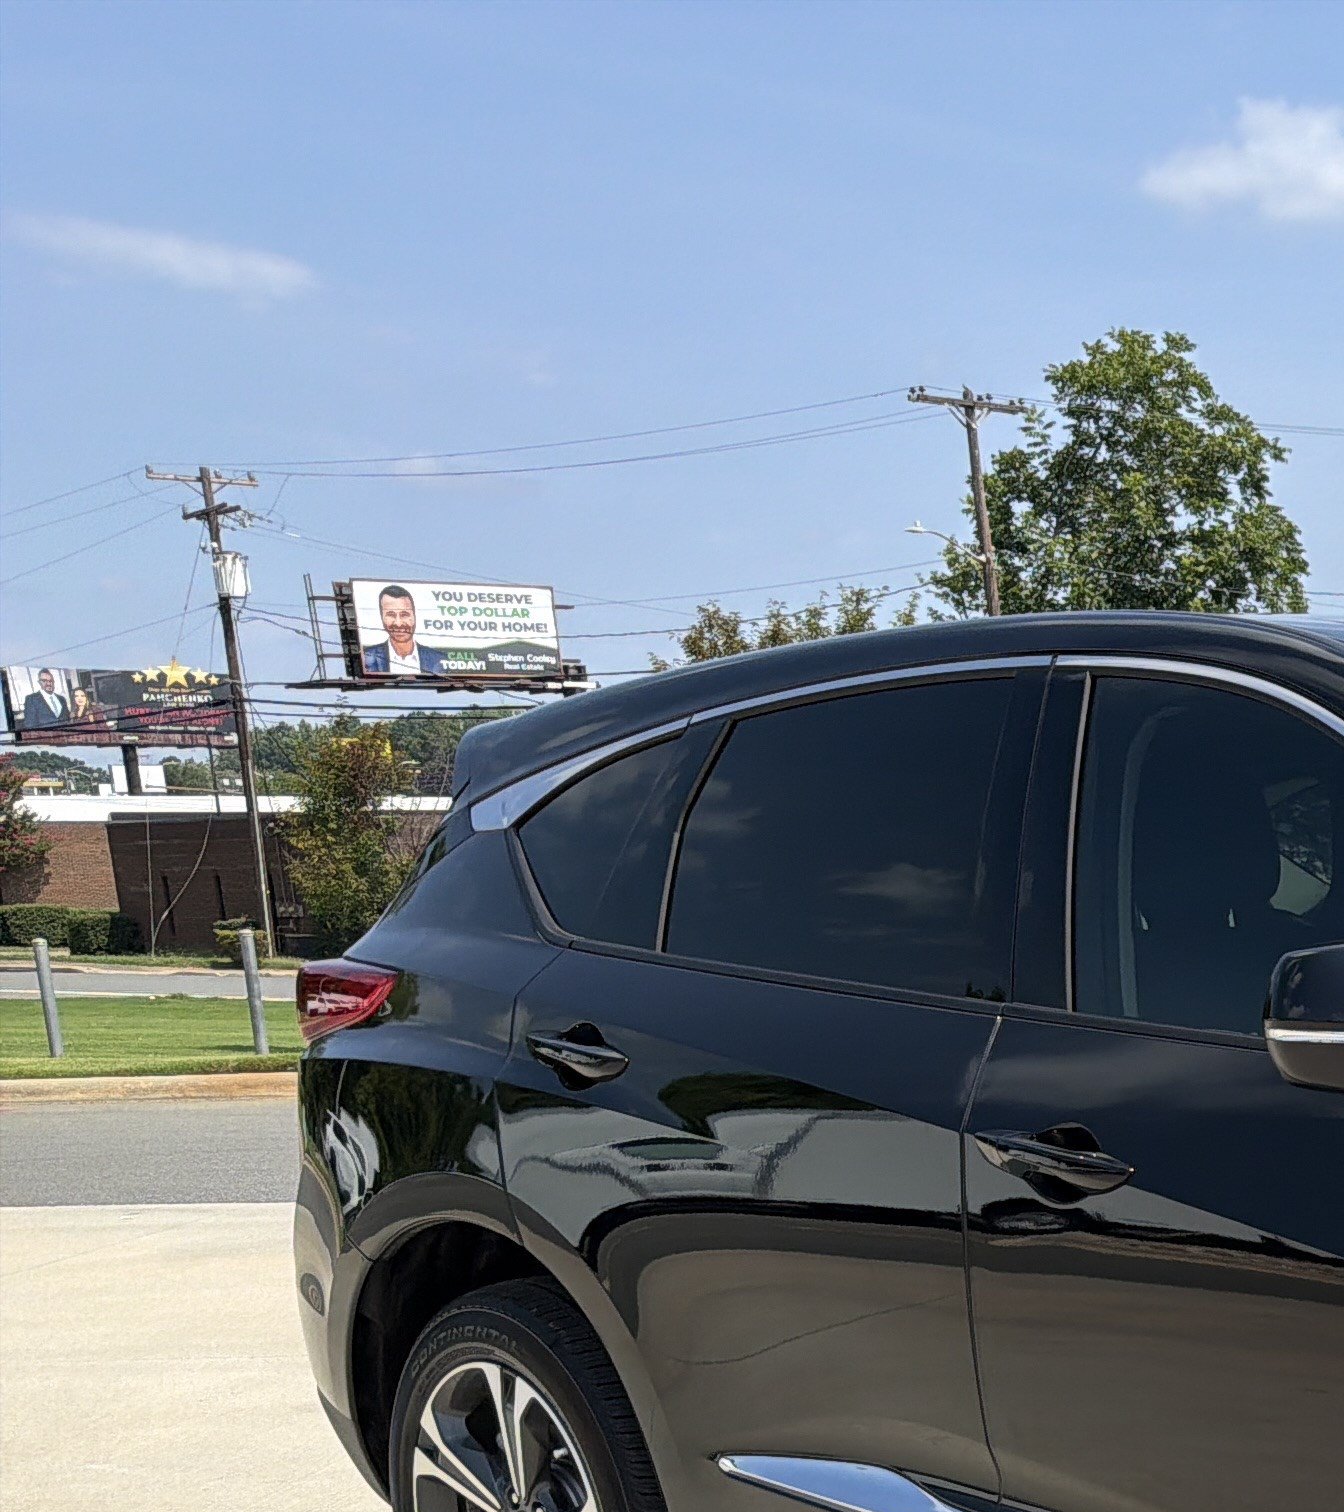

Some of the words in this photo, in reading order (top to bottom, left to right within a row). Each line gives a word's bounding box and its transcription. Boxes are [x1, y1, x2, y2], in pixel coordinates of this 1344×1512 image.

[432, 590, 463, 602] YOU
[468, 592, 533, 605] DESERVE
[438, 605, 468, 616] TOP
[472, 606, 530, 618] DOLLAR
[424, 618, 454, 631] FOR
[457, 619, 498, 632] YOUR
[502, 621, 548, 633] HOME!
[448, 651, 478, 661] CALL
[440, 660, 486, 670] TODAY!
